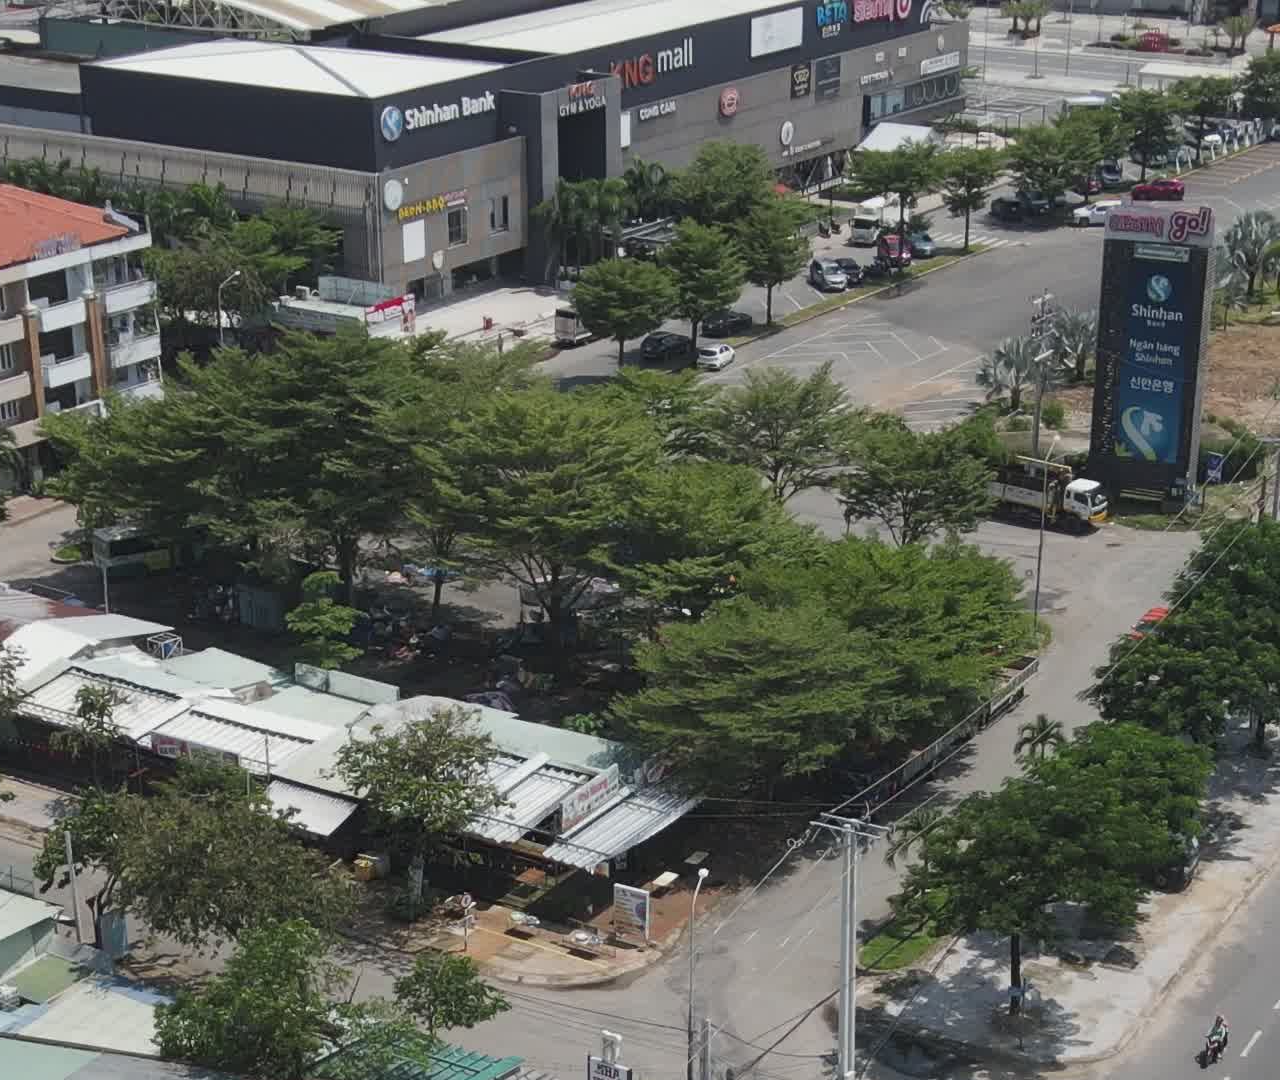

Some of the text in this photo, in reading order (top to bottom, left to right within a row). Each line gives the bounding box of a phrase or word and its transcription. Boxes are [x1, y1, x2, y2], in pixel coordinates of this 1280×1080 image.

[815, 2, 847, 26] BETA
[658, 36, 693, 73] mall
[405, 90, 496, 130] Shinhan Bank
[559, 100, 578, 117] GYM
[584, 95, 607, 111] YOGA
[1168, 206, 1212, 243] go!
[1130, 304, 1184, 322] Shinhan
